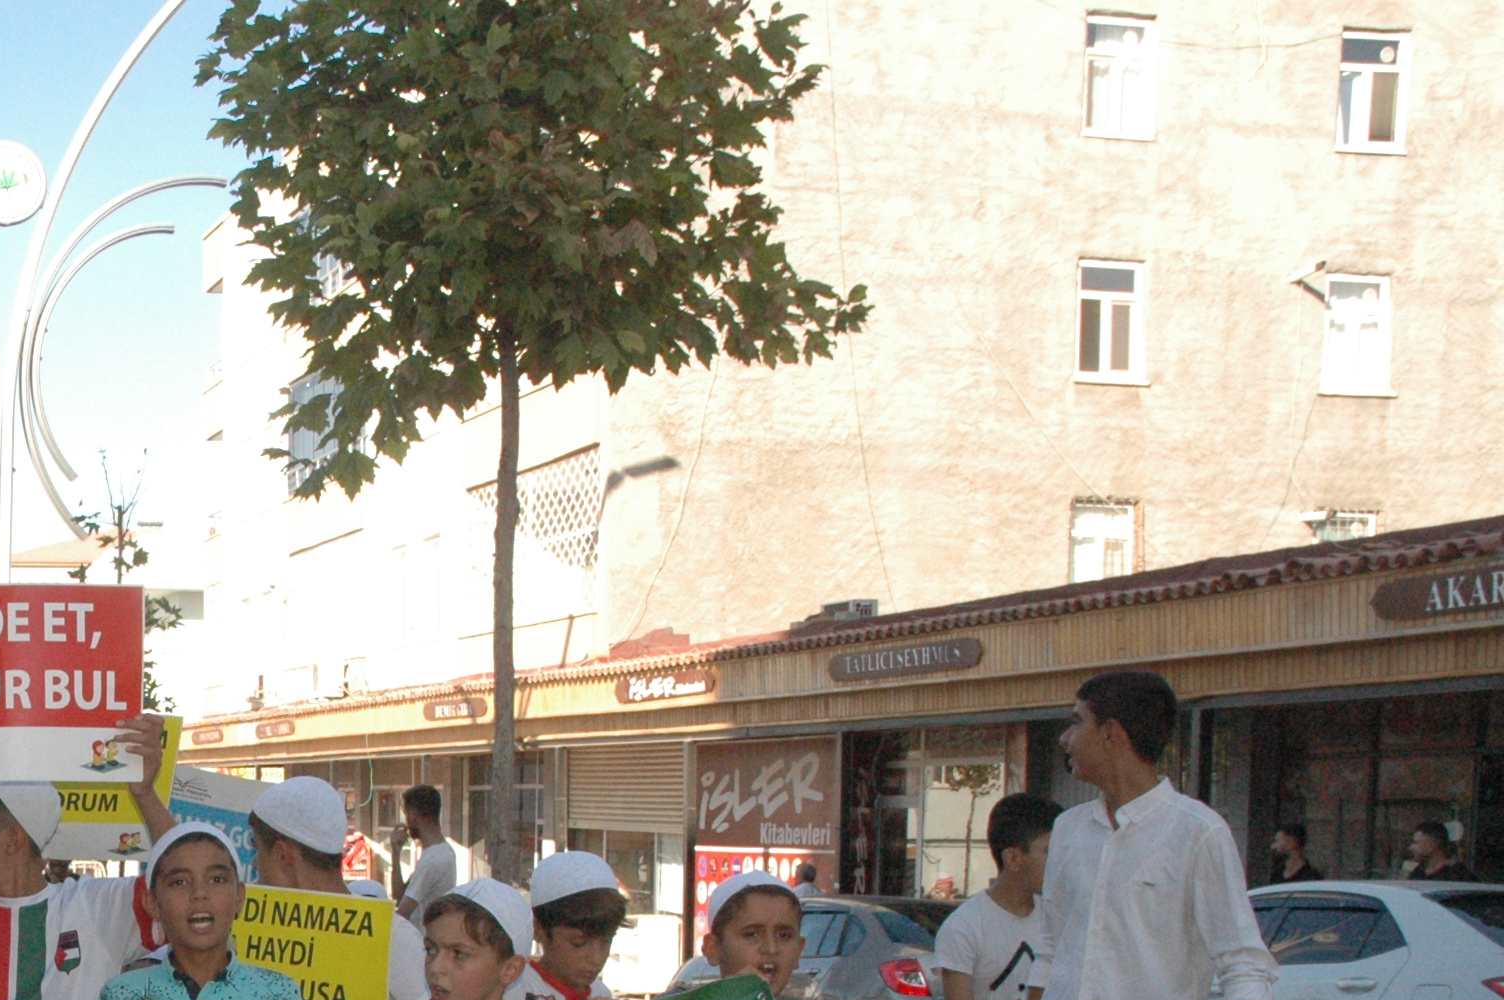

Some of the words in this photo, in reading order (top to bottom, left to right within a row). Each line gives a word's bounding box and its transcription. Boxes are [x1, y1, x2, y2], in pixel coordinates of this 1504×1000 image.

[43, 602, 102, 649] ET,
[845, 652, 893, 674] TATLICI
[44, 669, 127, 712] BUL
[760, 822, 830, 846] Kitabevleri
[271, 899, 373, 937] NAMAZA
[246, 934, 314, 968] HAYDİ
